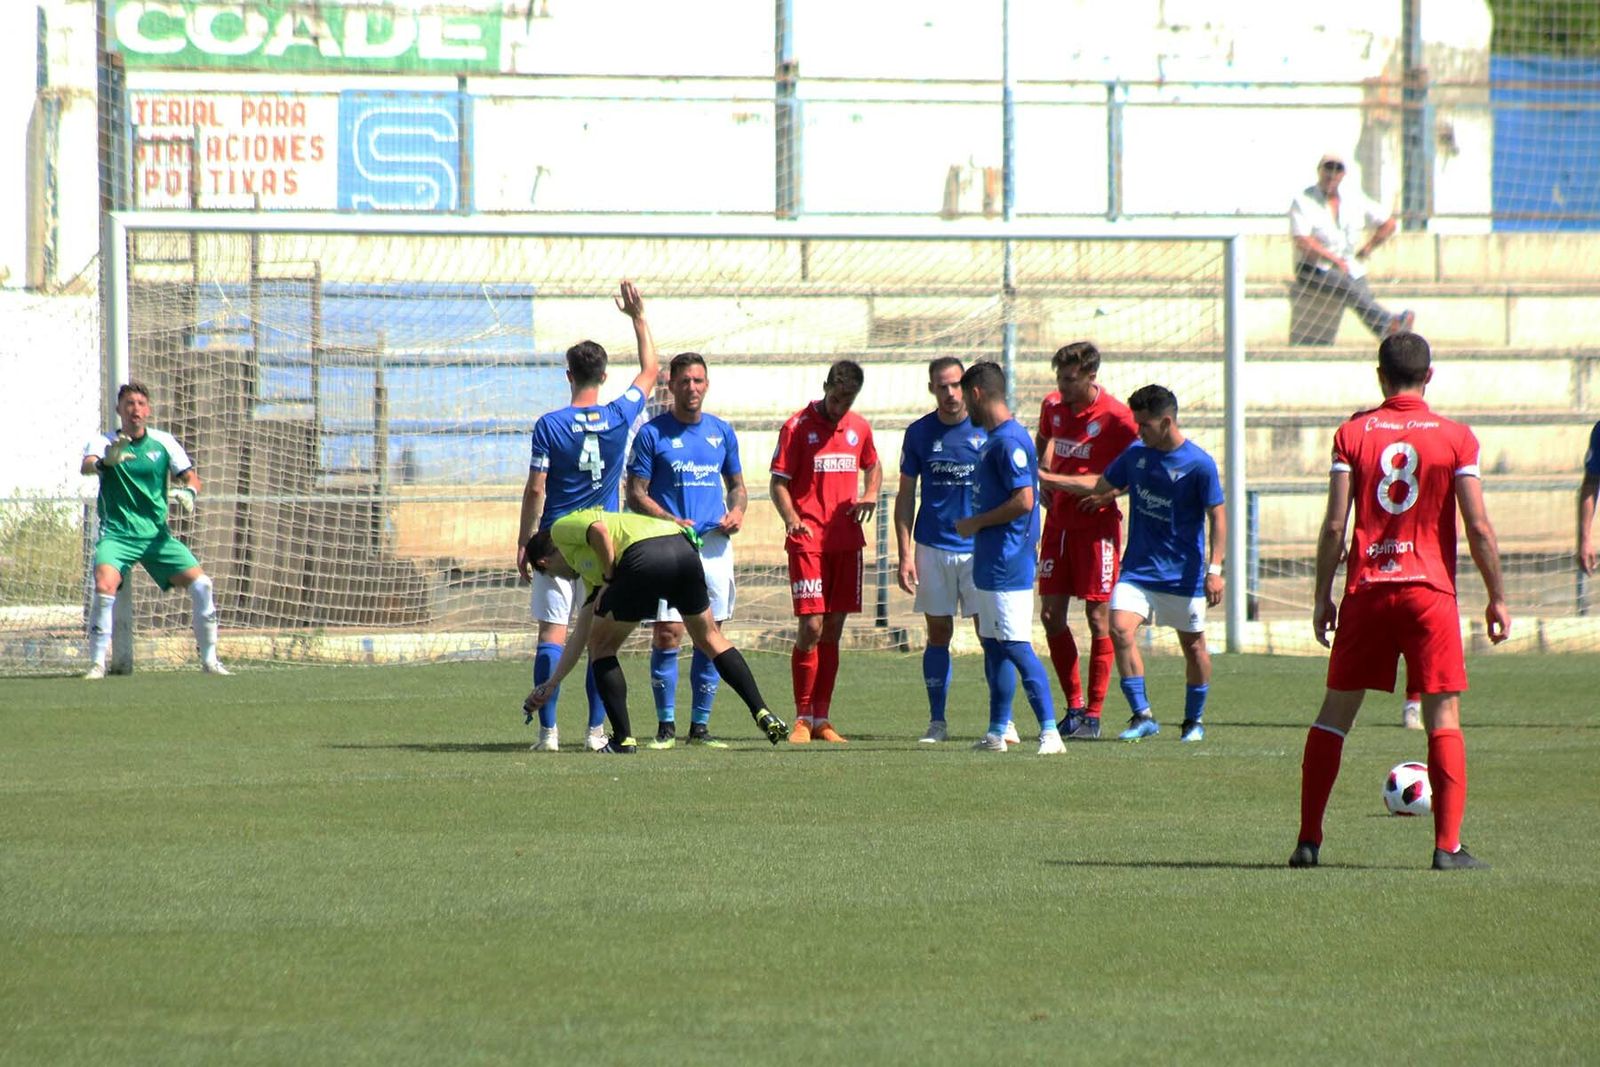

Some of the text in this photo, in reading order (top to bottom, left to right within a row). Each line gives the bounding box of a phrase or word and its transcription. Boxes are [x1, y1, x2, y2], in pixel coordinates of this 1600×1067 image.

[115, 1, 487, 60] COADE
[136, 99, 306, 127] TERIAL PARA
[145, 168, 298, 195] POTIVAS
[579, 432, 605, 481] 4
[1377, 441, 1419, 514] 8
[1101, 538, 1114, 584] XEREZ
